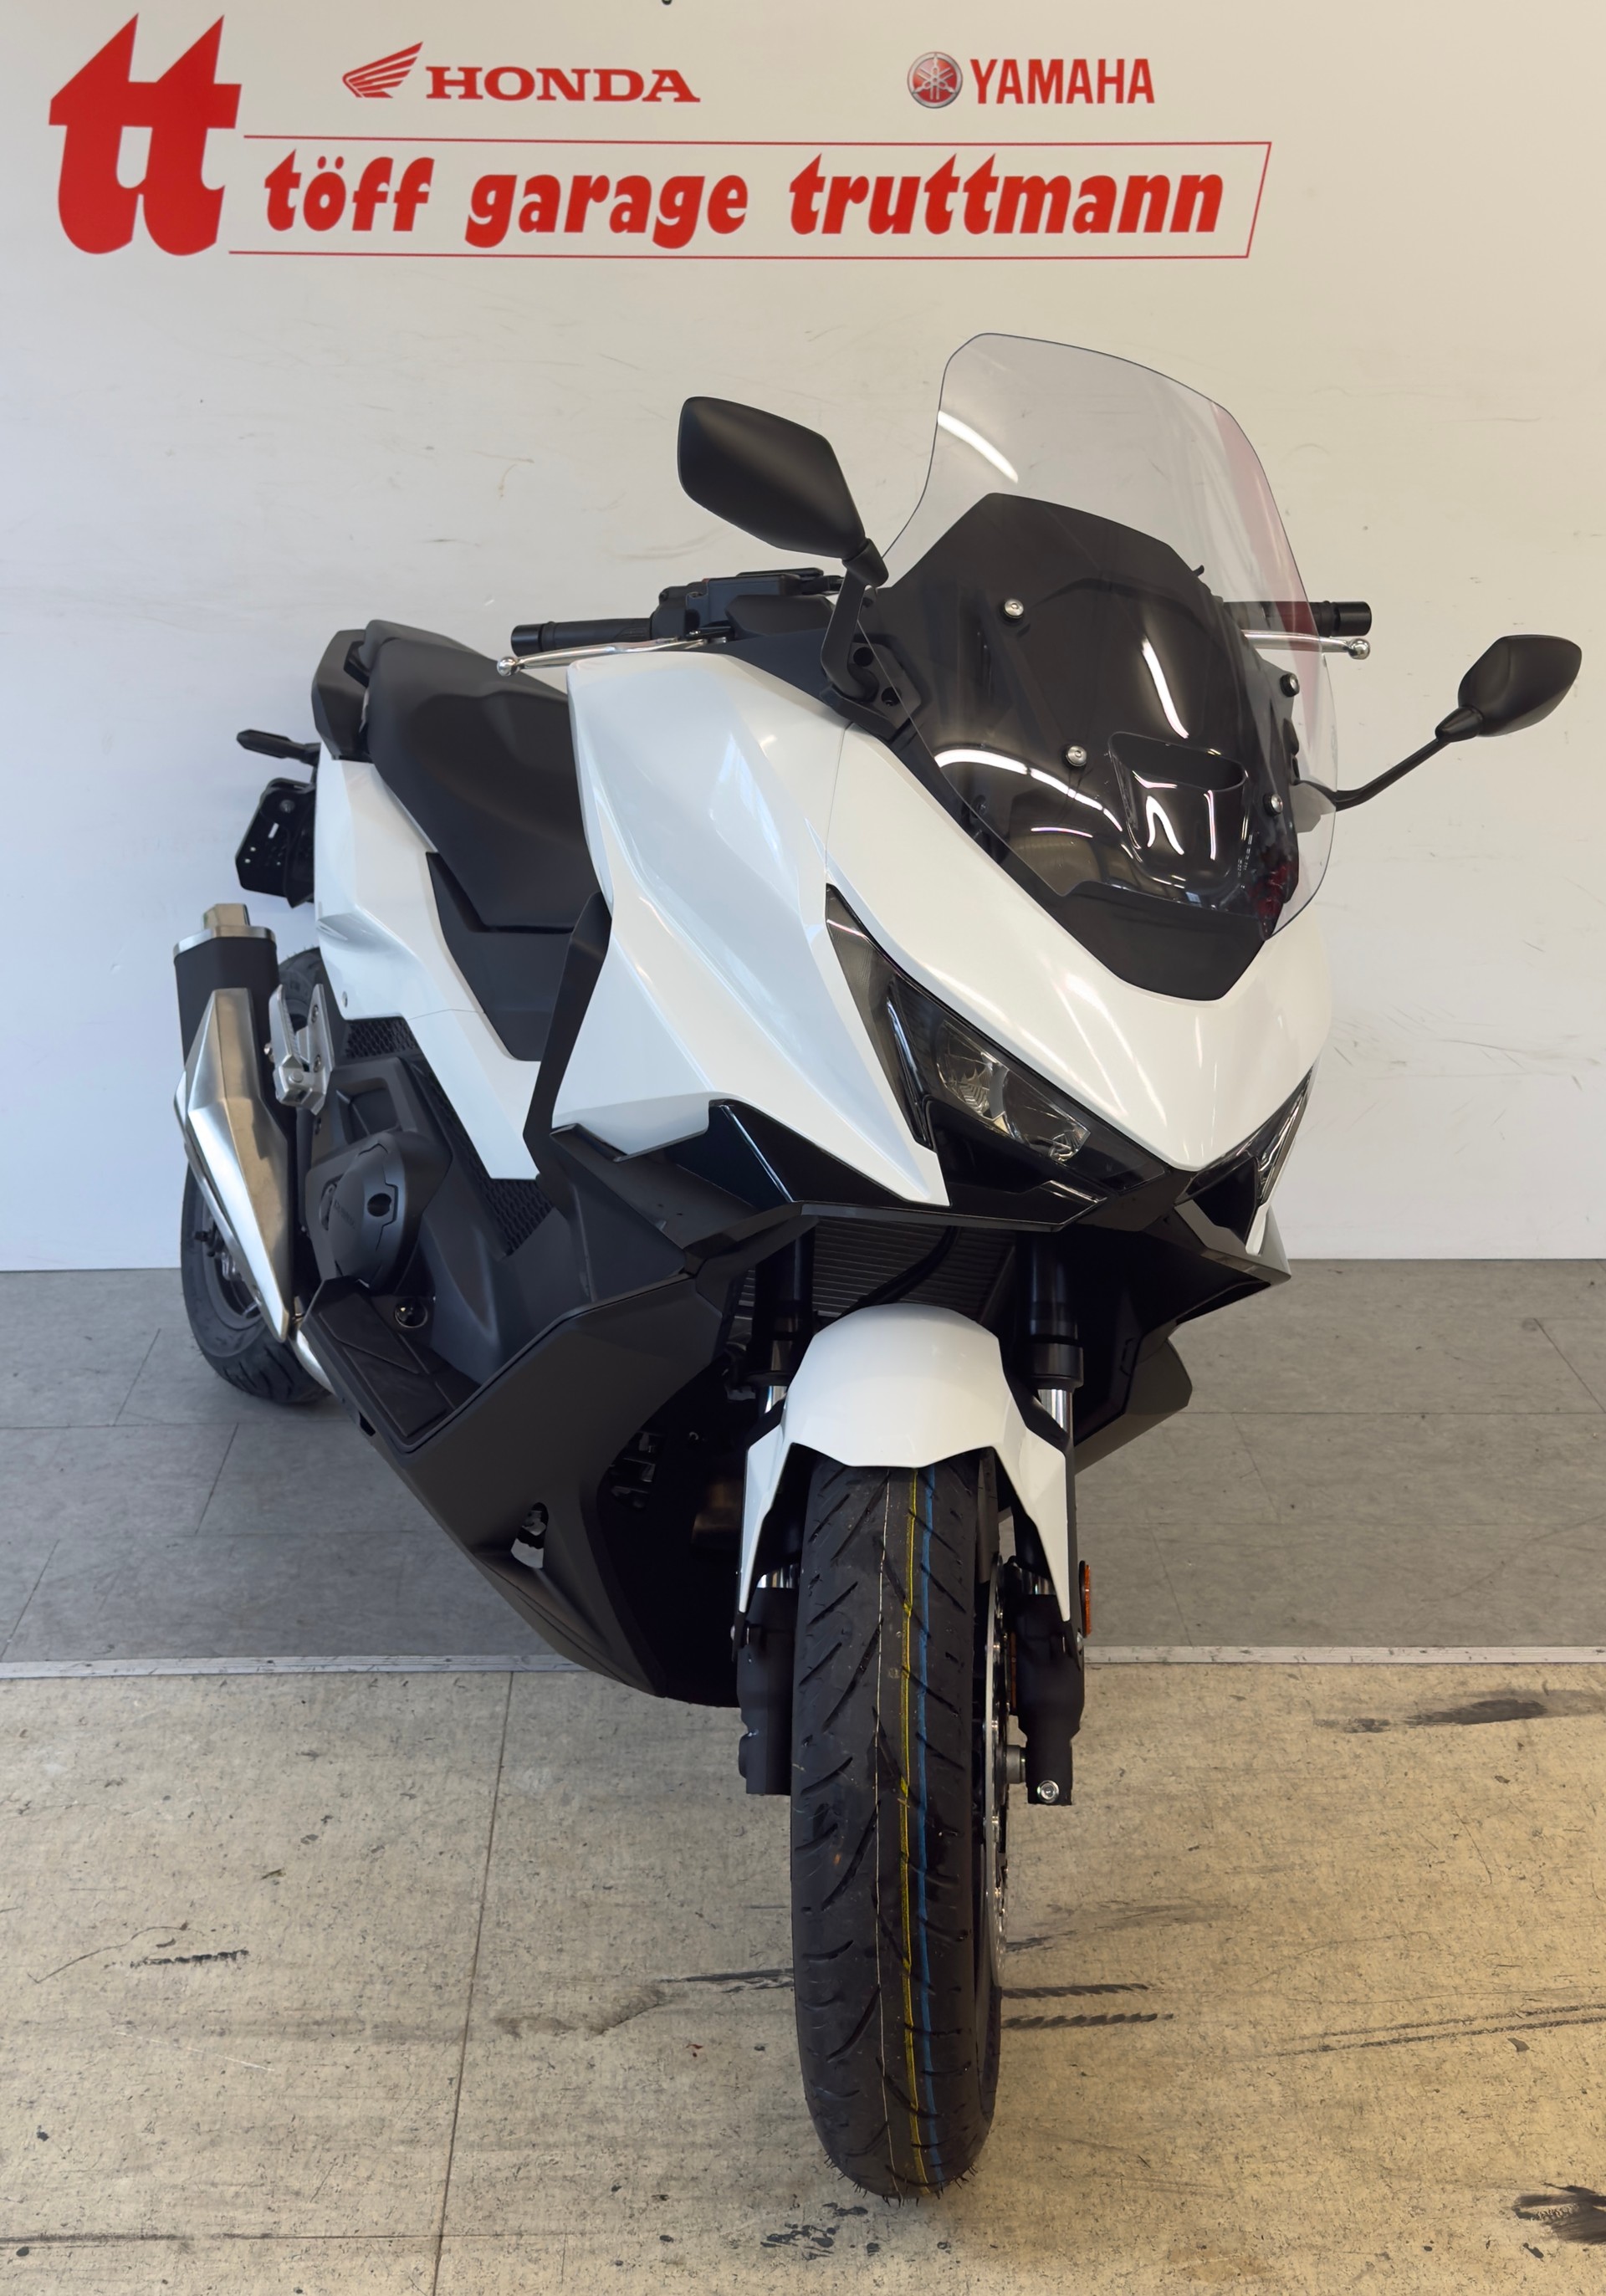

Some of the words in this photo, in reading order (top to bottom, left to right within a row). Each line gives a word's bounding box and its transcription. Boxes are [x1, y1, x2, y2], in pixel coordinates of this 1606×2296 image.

[426, 66, 700, 102] HONDA
[969, 59, 1155, 105] YAMAHA
[264, 150, 434, 232] töff
[465, 174, 749, 249] garage
[789, 153, 1224, 235] truttmann
